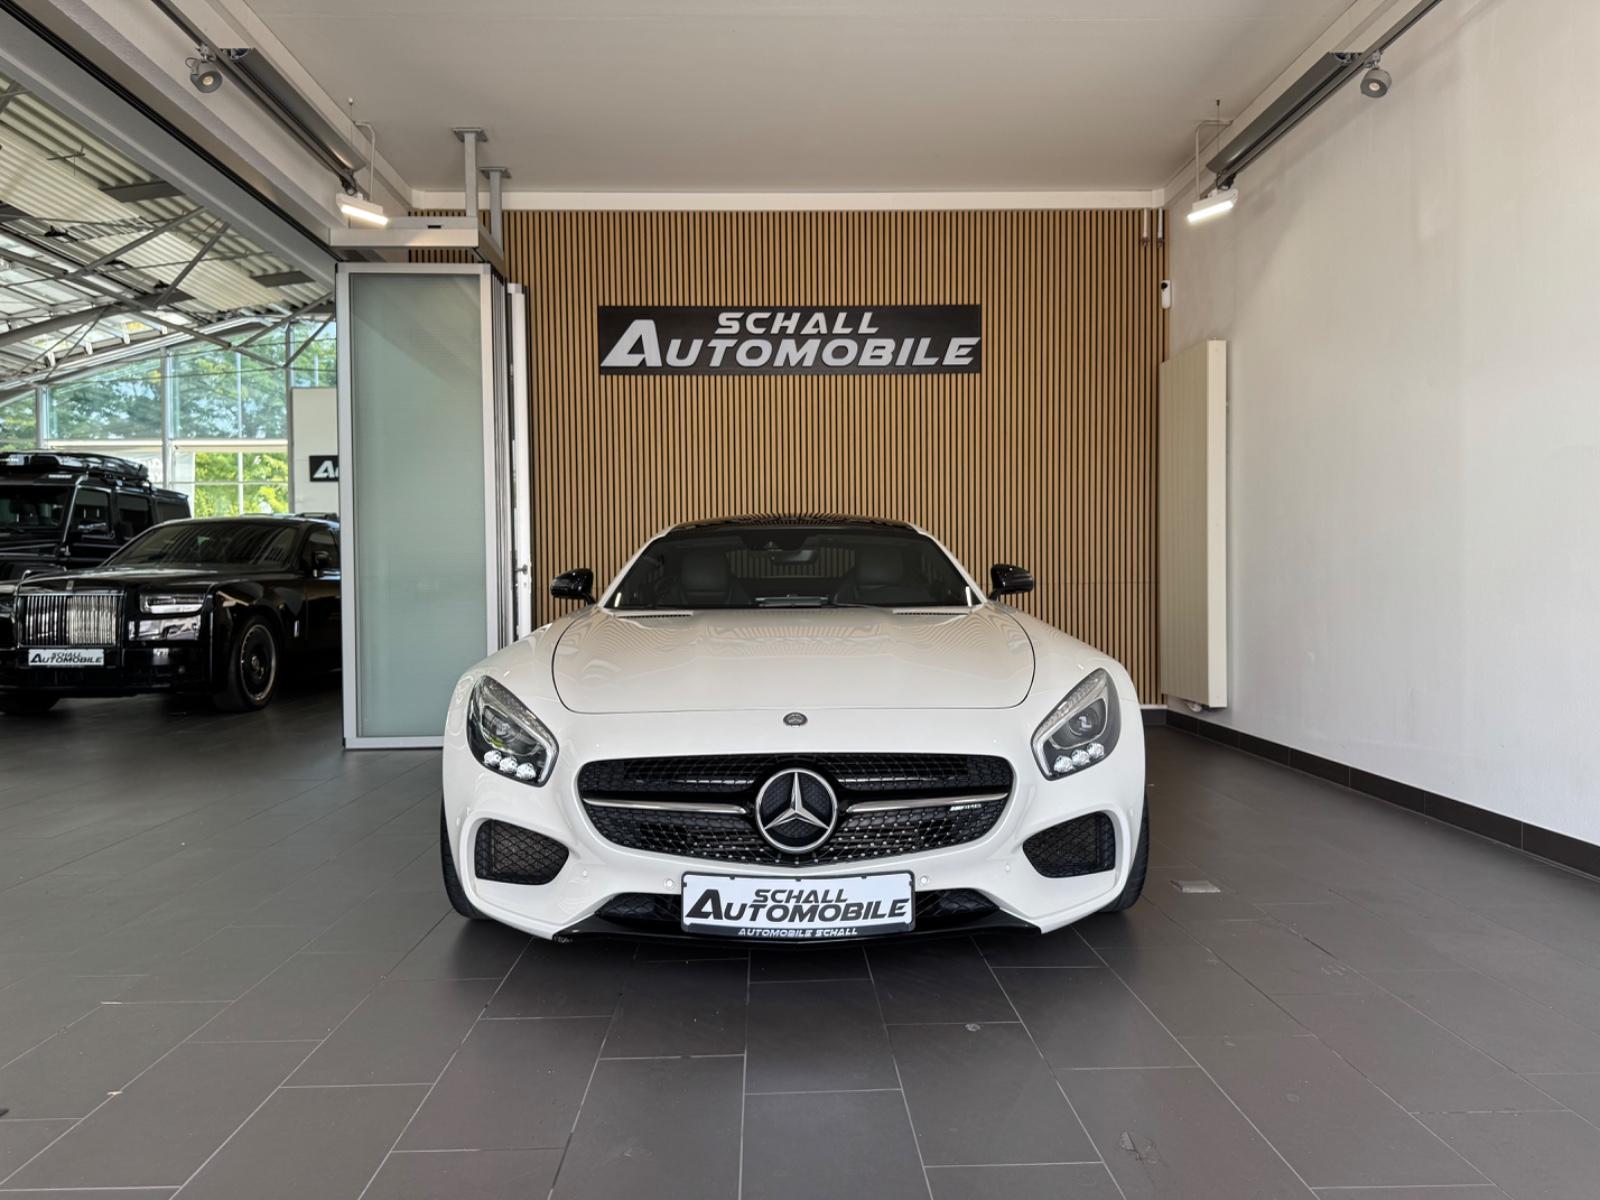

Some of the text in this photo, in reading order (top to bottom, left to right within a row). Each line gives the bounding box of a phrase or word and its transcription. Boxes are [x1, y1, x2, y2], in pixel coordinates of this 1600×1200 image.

[714, 311, 880, 335] SCHALL
[600, 318, 981, 368] AUTOMOBILE
[685, 888, 910, 923] AUTOMOBILE
[752, 888, 848, 904] SCHALL
[738, 927, 858, 938] AUTOMOBILE SCHALL
